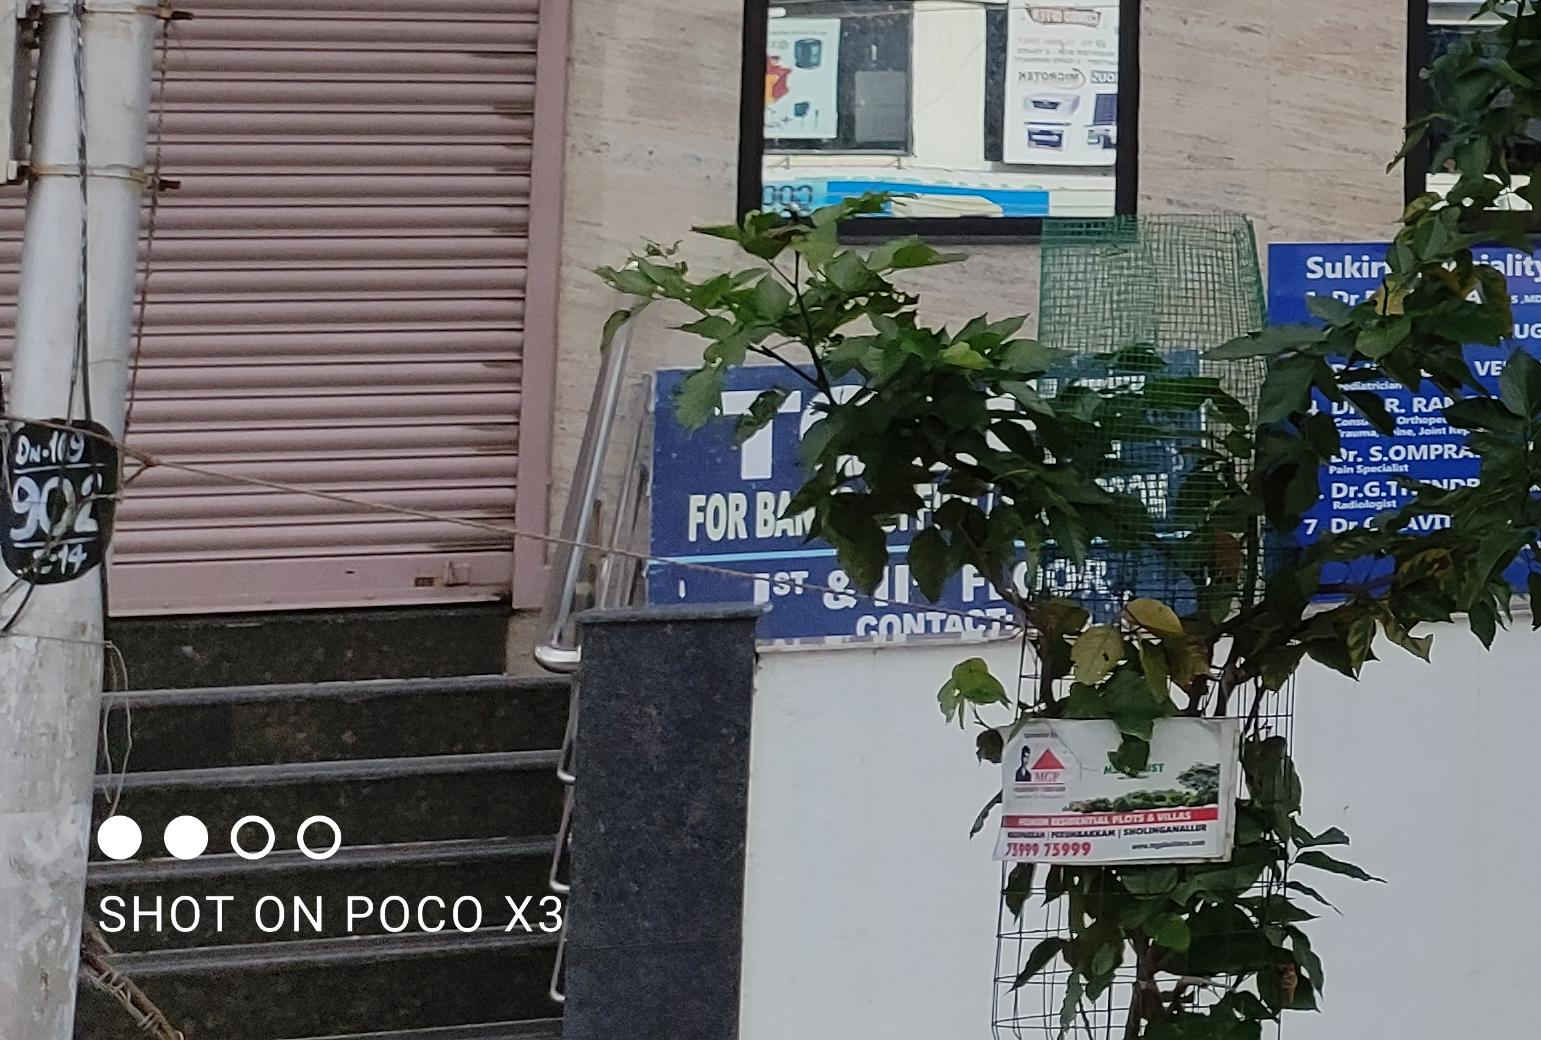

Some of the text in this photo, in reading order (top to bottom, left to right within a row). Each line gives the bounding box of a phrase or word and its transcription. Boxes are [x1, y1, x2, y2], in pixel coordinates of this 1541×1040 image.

[1306, 255, 1393, 279] Sukir
[1419, 427, 1447, 436] Joint
[1369, 443, 1481, 461] S.OMPRA
[1329, 464, 1409, 475] Pain Specialist
[10, 474, 103, 541] 902
[1333, 500, 1397, 510] Radiologist
[688, 493, 748, 543] FOR
[756, 490, 817, 539] BAN
[822, 569, 857, 610] &
[1112, 813, 1144, 824] PLOTS
[1157, 811, 1191, 821] VILLAS
[1005, 841, 1092, 857] 75999 75999
